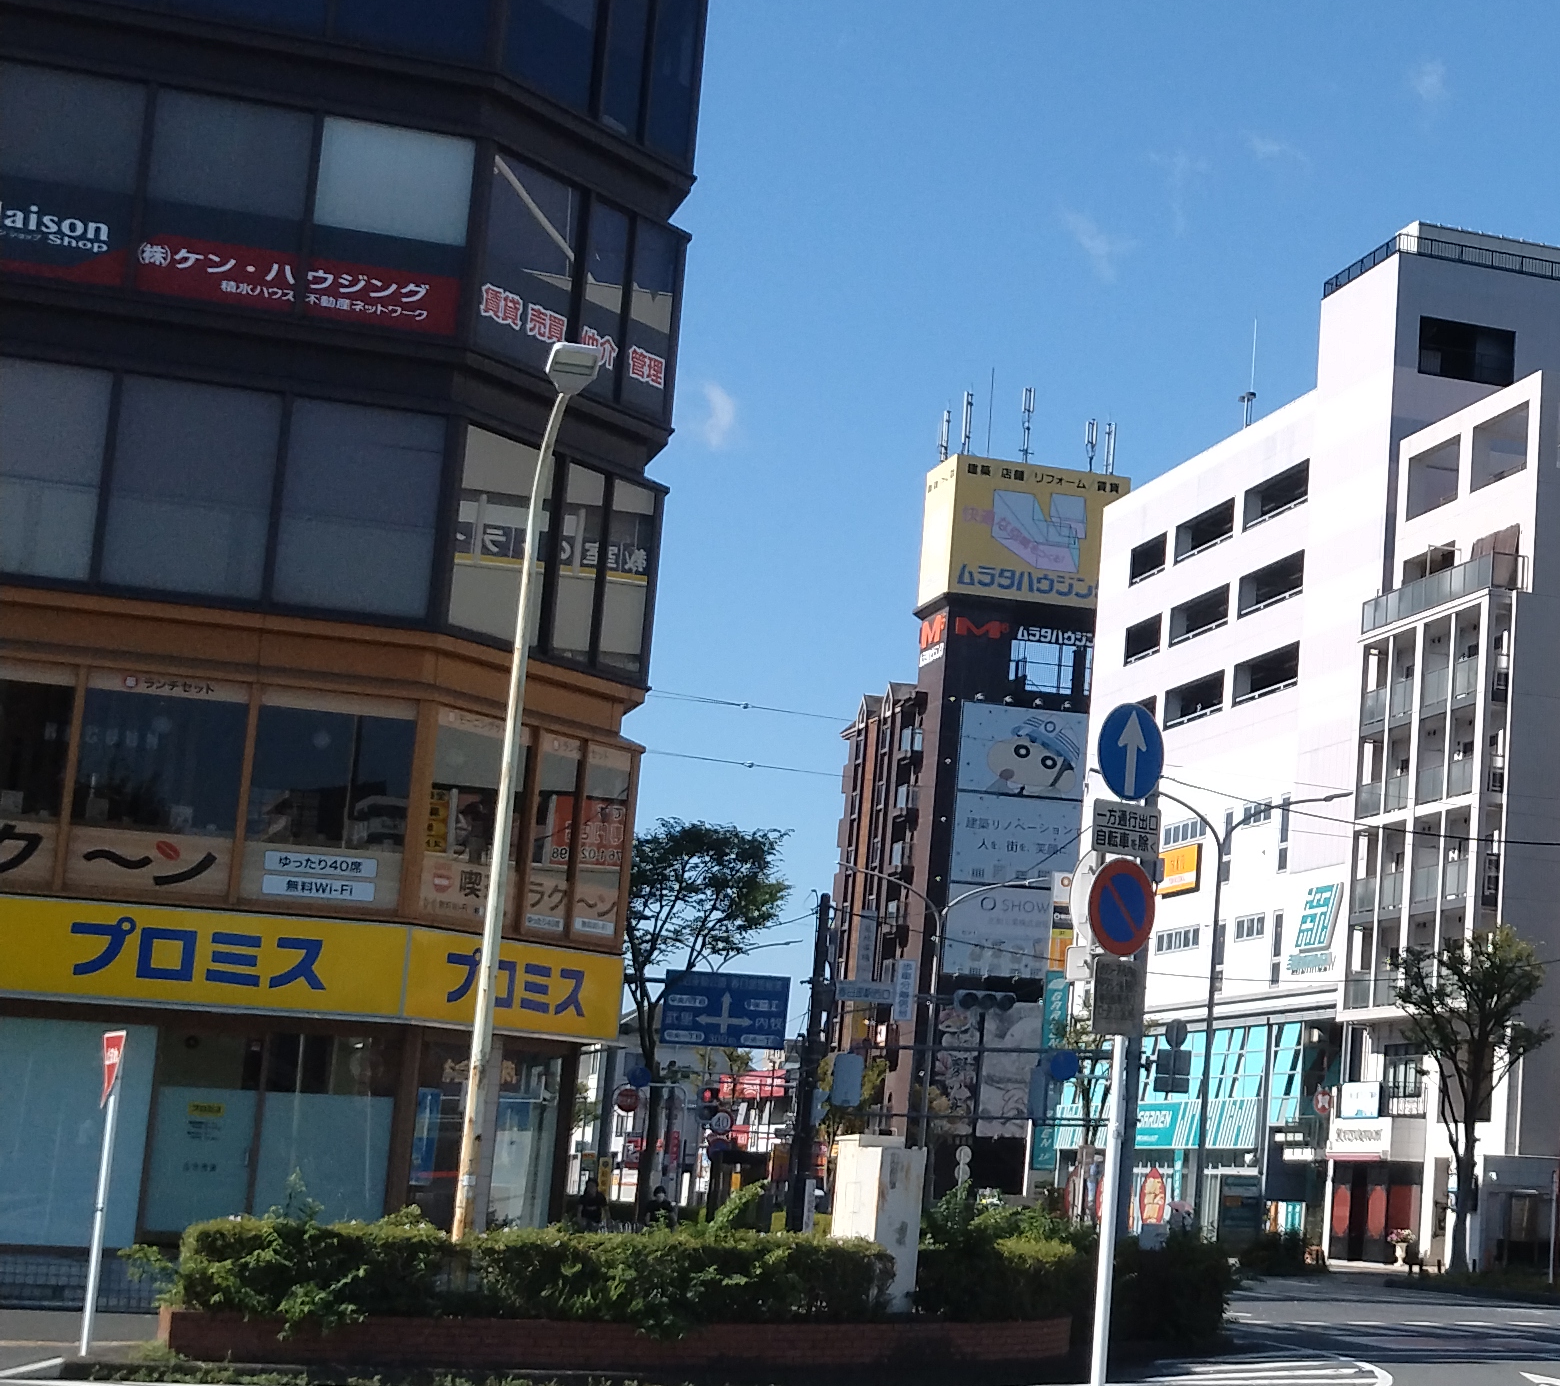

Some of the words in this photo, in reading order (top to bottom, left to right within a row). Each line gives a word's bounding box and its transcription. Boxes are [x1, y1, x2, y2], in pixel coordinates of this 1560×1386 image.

[47, 234, 109, 253] Shop
[480, 283, 523, 331] 賃貸
[527, 302, 568, 343] 売買
[629, 345, 666, 390] 管理
[1096, 807, 1159, 831] 一方通行出口
[1095, 828, 1157, 855] 自転車を除く
[278, 855, 364, 874] ゆったり40席
[285, 879, 354, 898] 無料Wi-Fi
[70, 915, 327, 991] プロミス
[446, 946, 586, 1018] プロミス
